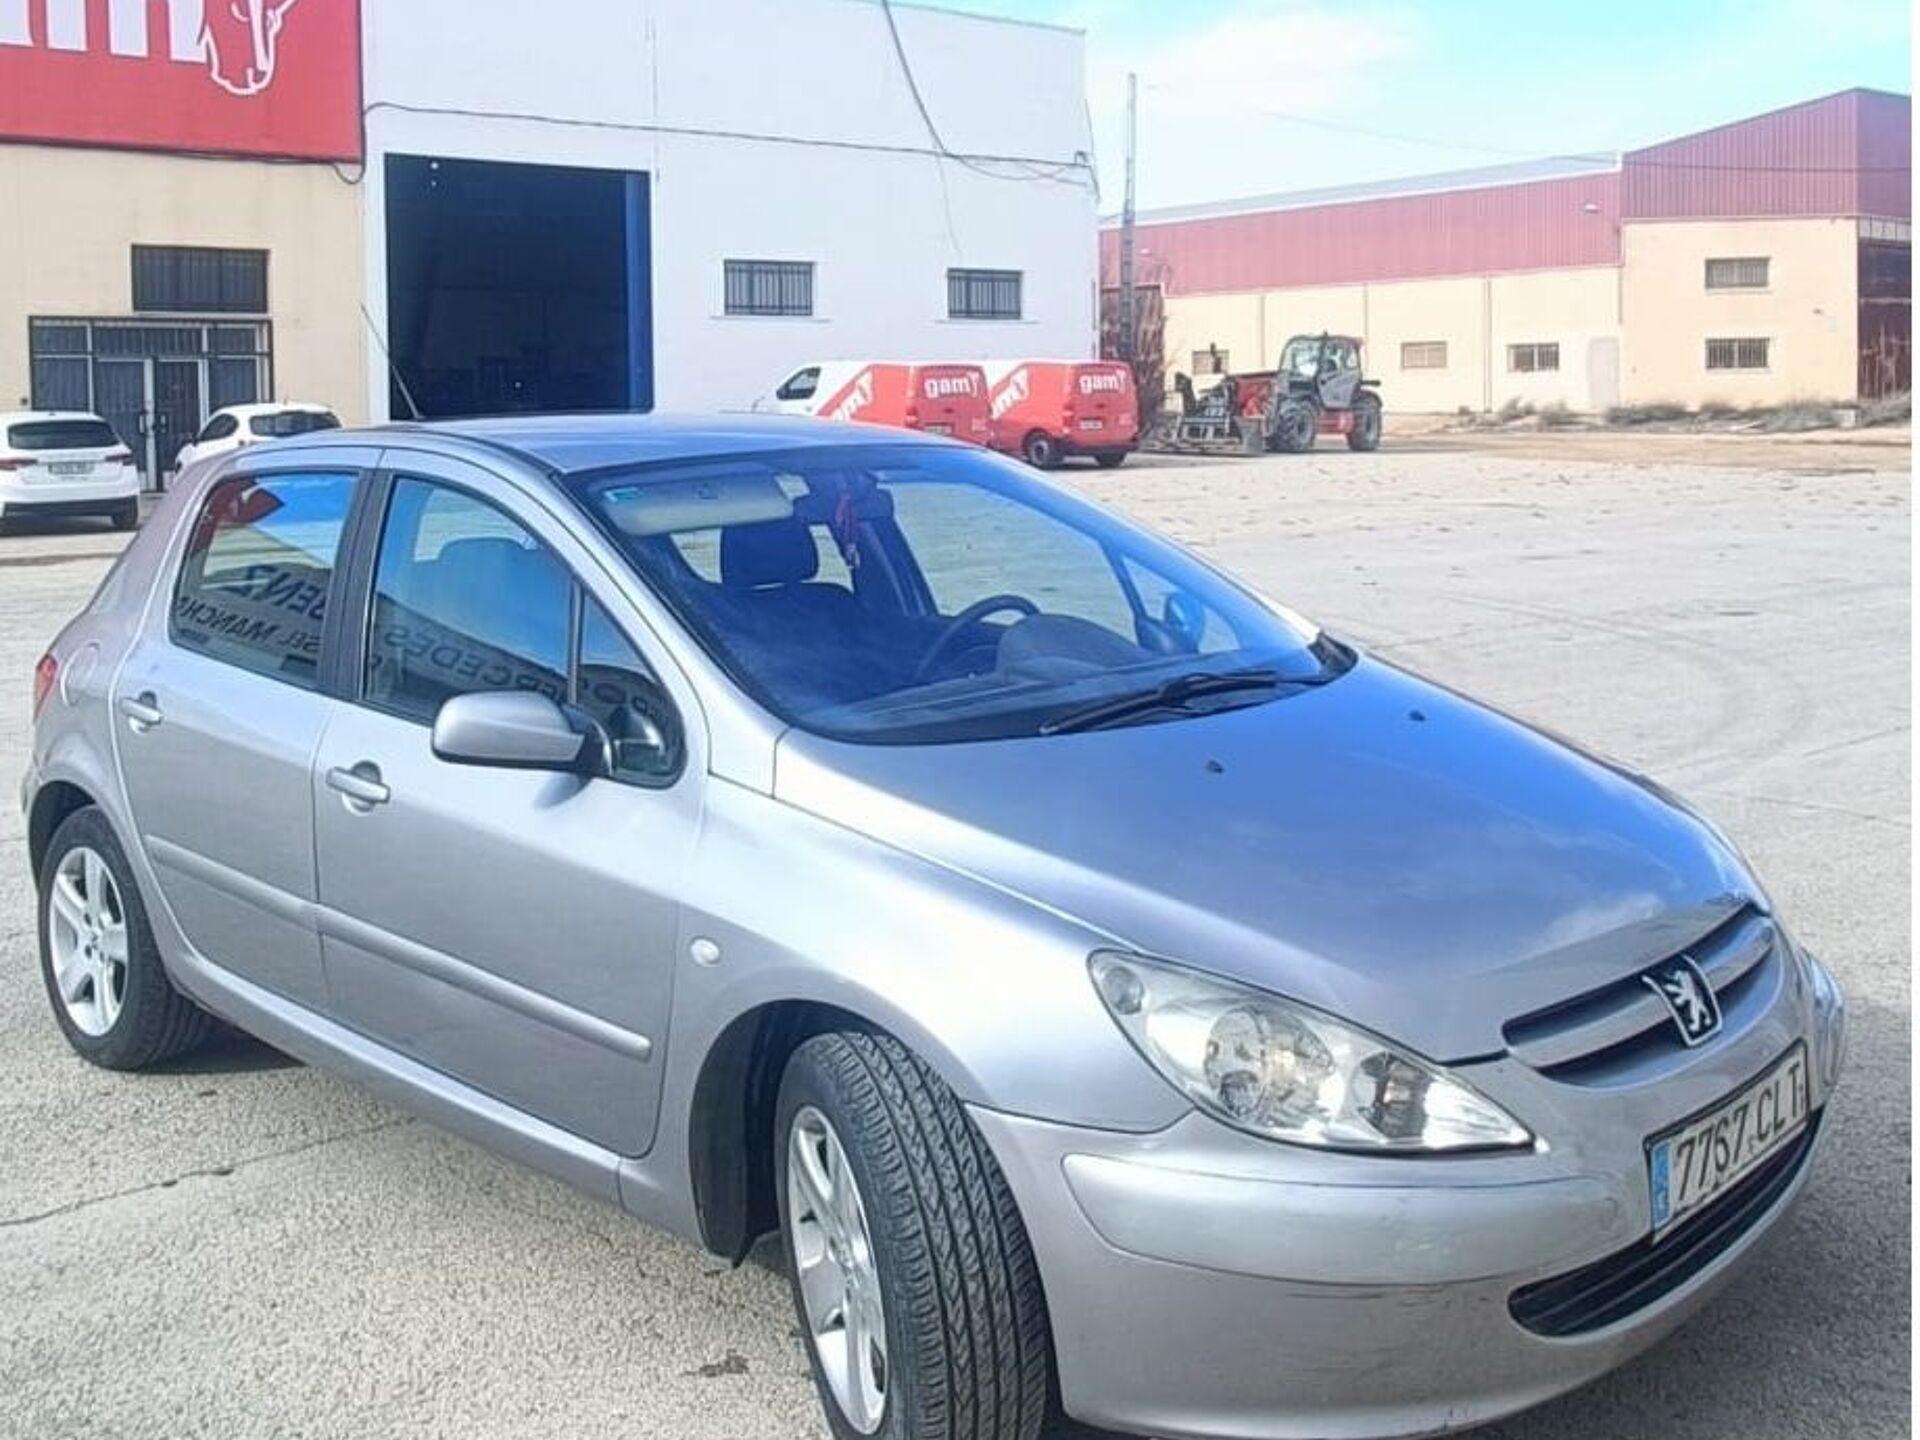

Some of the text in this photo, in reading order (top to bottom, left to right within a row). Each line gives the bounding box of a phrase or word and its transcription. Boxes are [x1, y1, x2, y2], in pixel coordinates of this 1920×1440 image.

[925, 376, 971, 399] gam
[1080, 373, 1119, 394] gam
[1677, 1061, 1801, 1201] 7767 CLT
